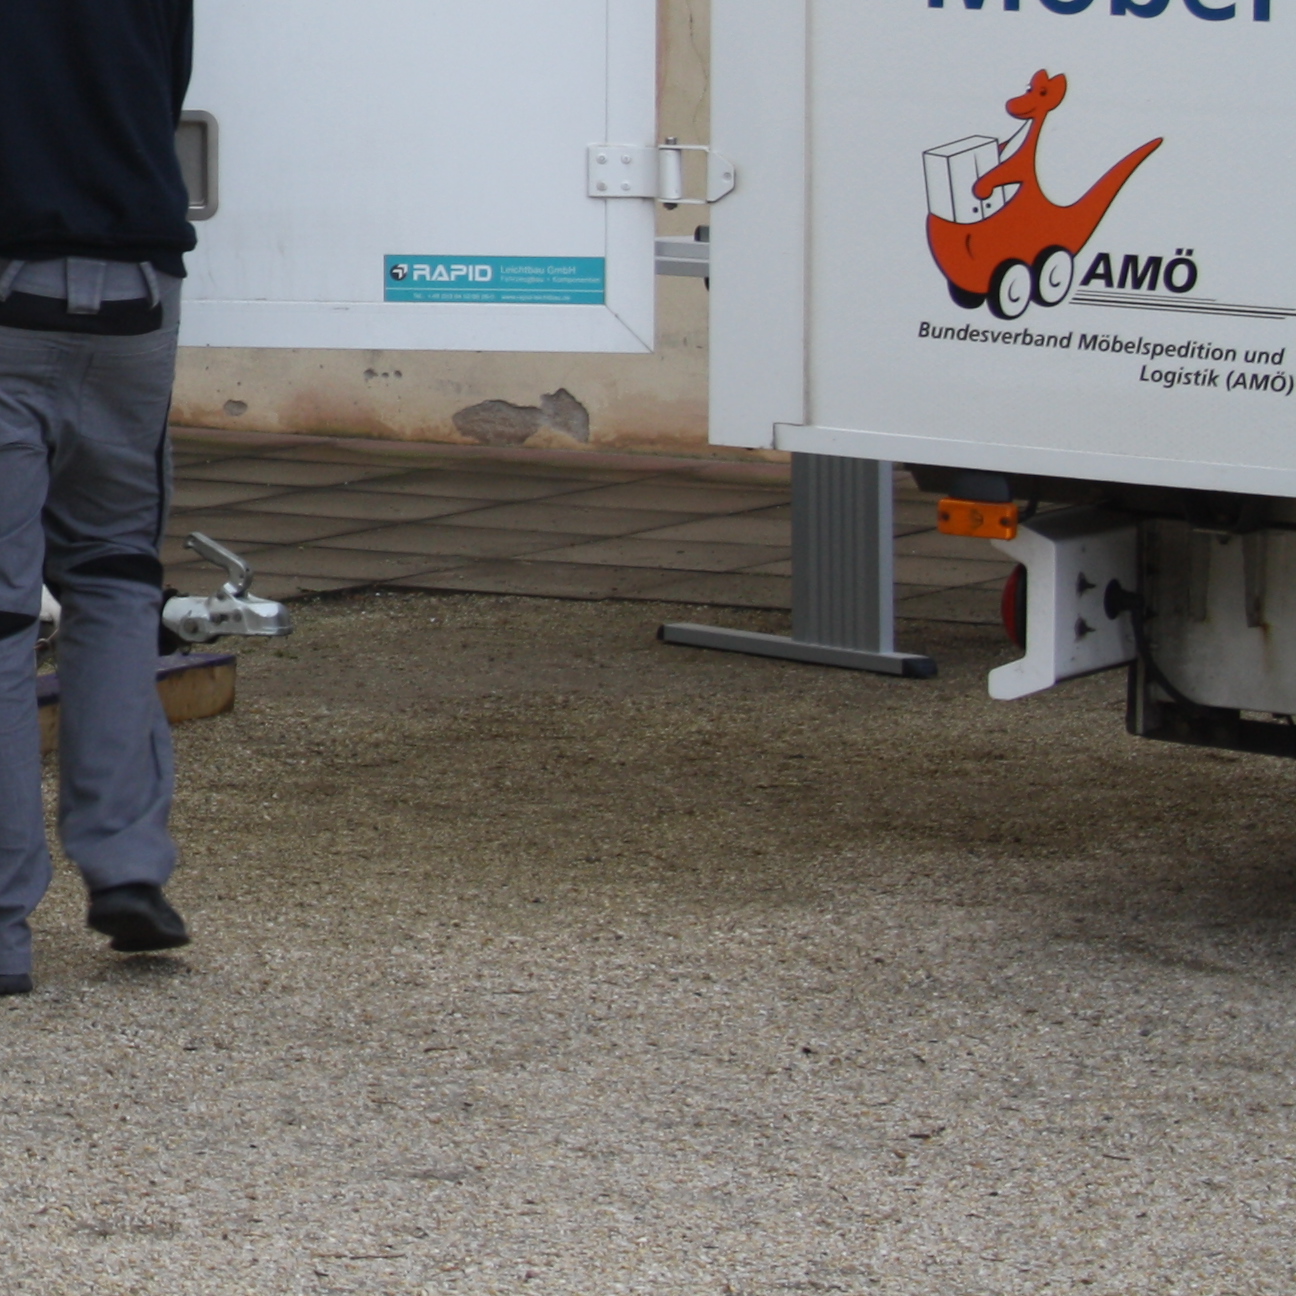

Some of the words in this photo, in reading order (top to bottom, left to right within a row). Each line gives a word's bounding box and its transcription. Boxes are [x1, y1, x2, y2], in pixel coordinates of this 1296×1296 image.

[412, 263, 493, 282] RAPID
[547, 266, 577, 275] GmbH
[1079, 247, 1198, 293] AMÖ
[917, 321, 1074, 349] Bundesverband
[1077, 333, 1237, 362] Möbelspedition
[1243, 347, 1286, 365] und
[1139, 364, 1220, 389] Logistik
[1226, 369, 1295, 397] (AMÖ)
